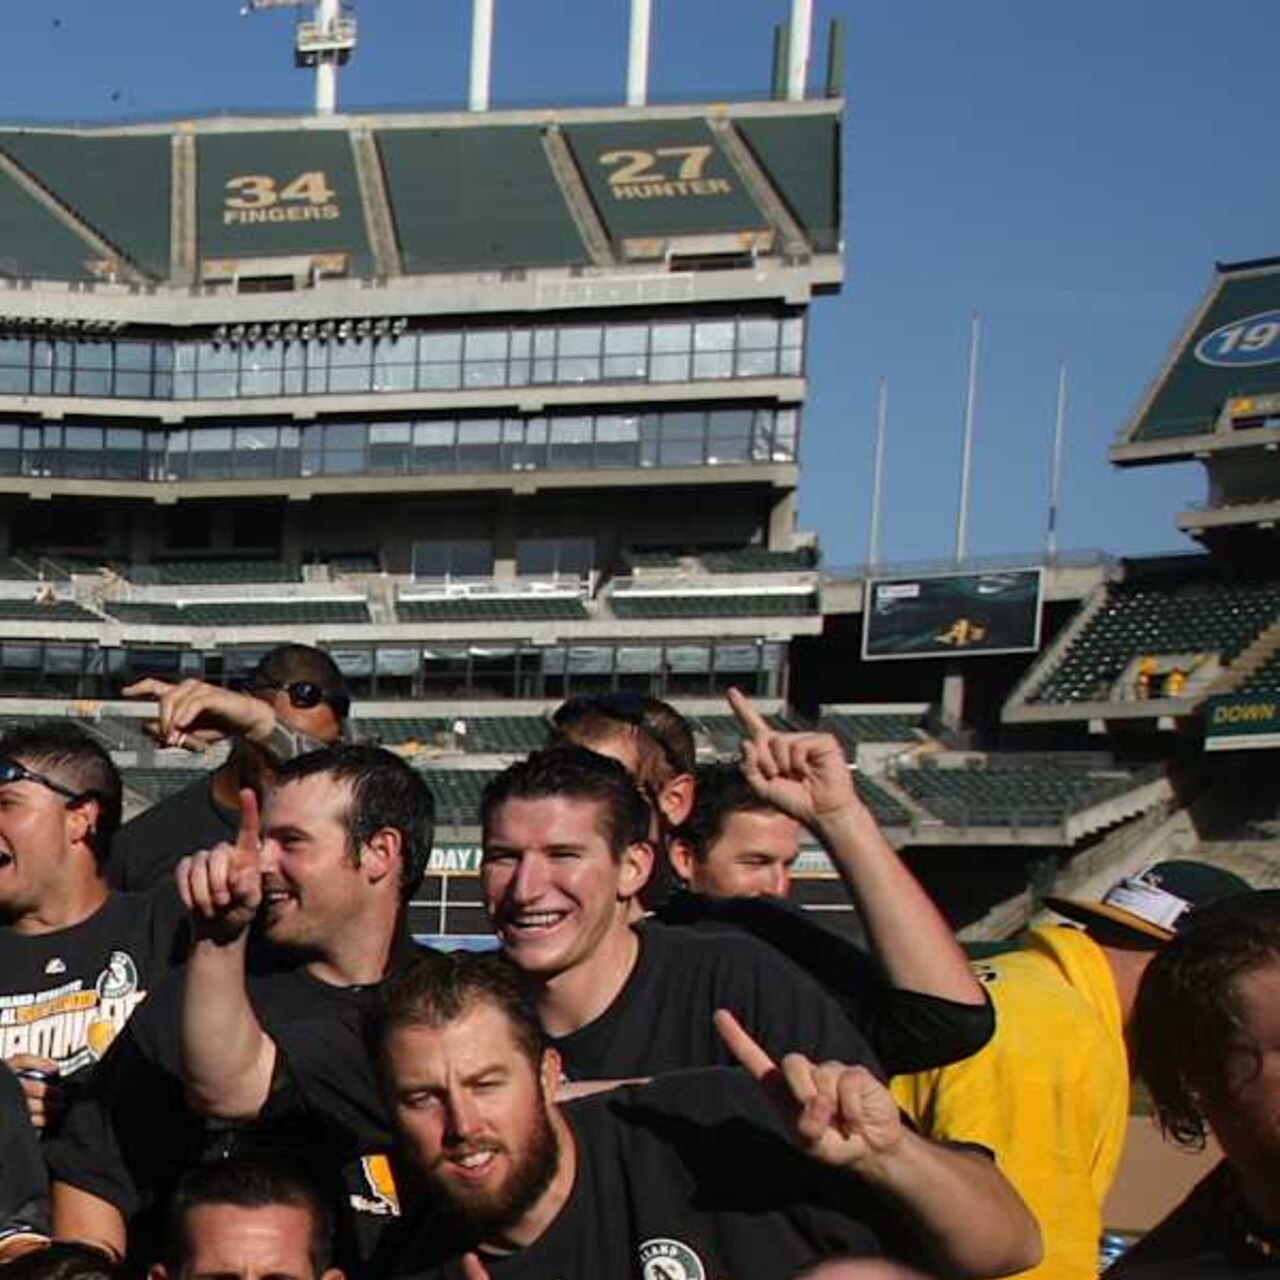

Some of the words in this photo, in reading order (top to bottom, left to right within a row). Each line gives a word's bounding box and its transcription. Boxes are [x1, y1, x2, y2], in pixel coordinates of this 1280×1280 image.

[599, 146, 714, 183] 27
[224, 171, 334, 209] 34
[611, 178, 731, 200] HUNTER
[222, 203, 341, 225] FINGERS
[1213, 704, 1276, 723] DOWN
